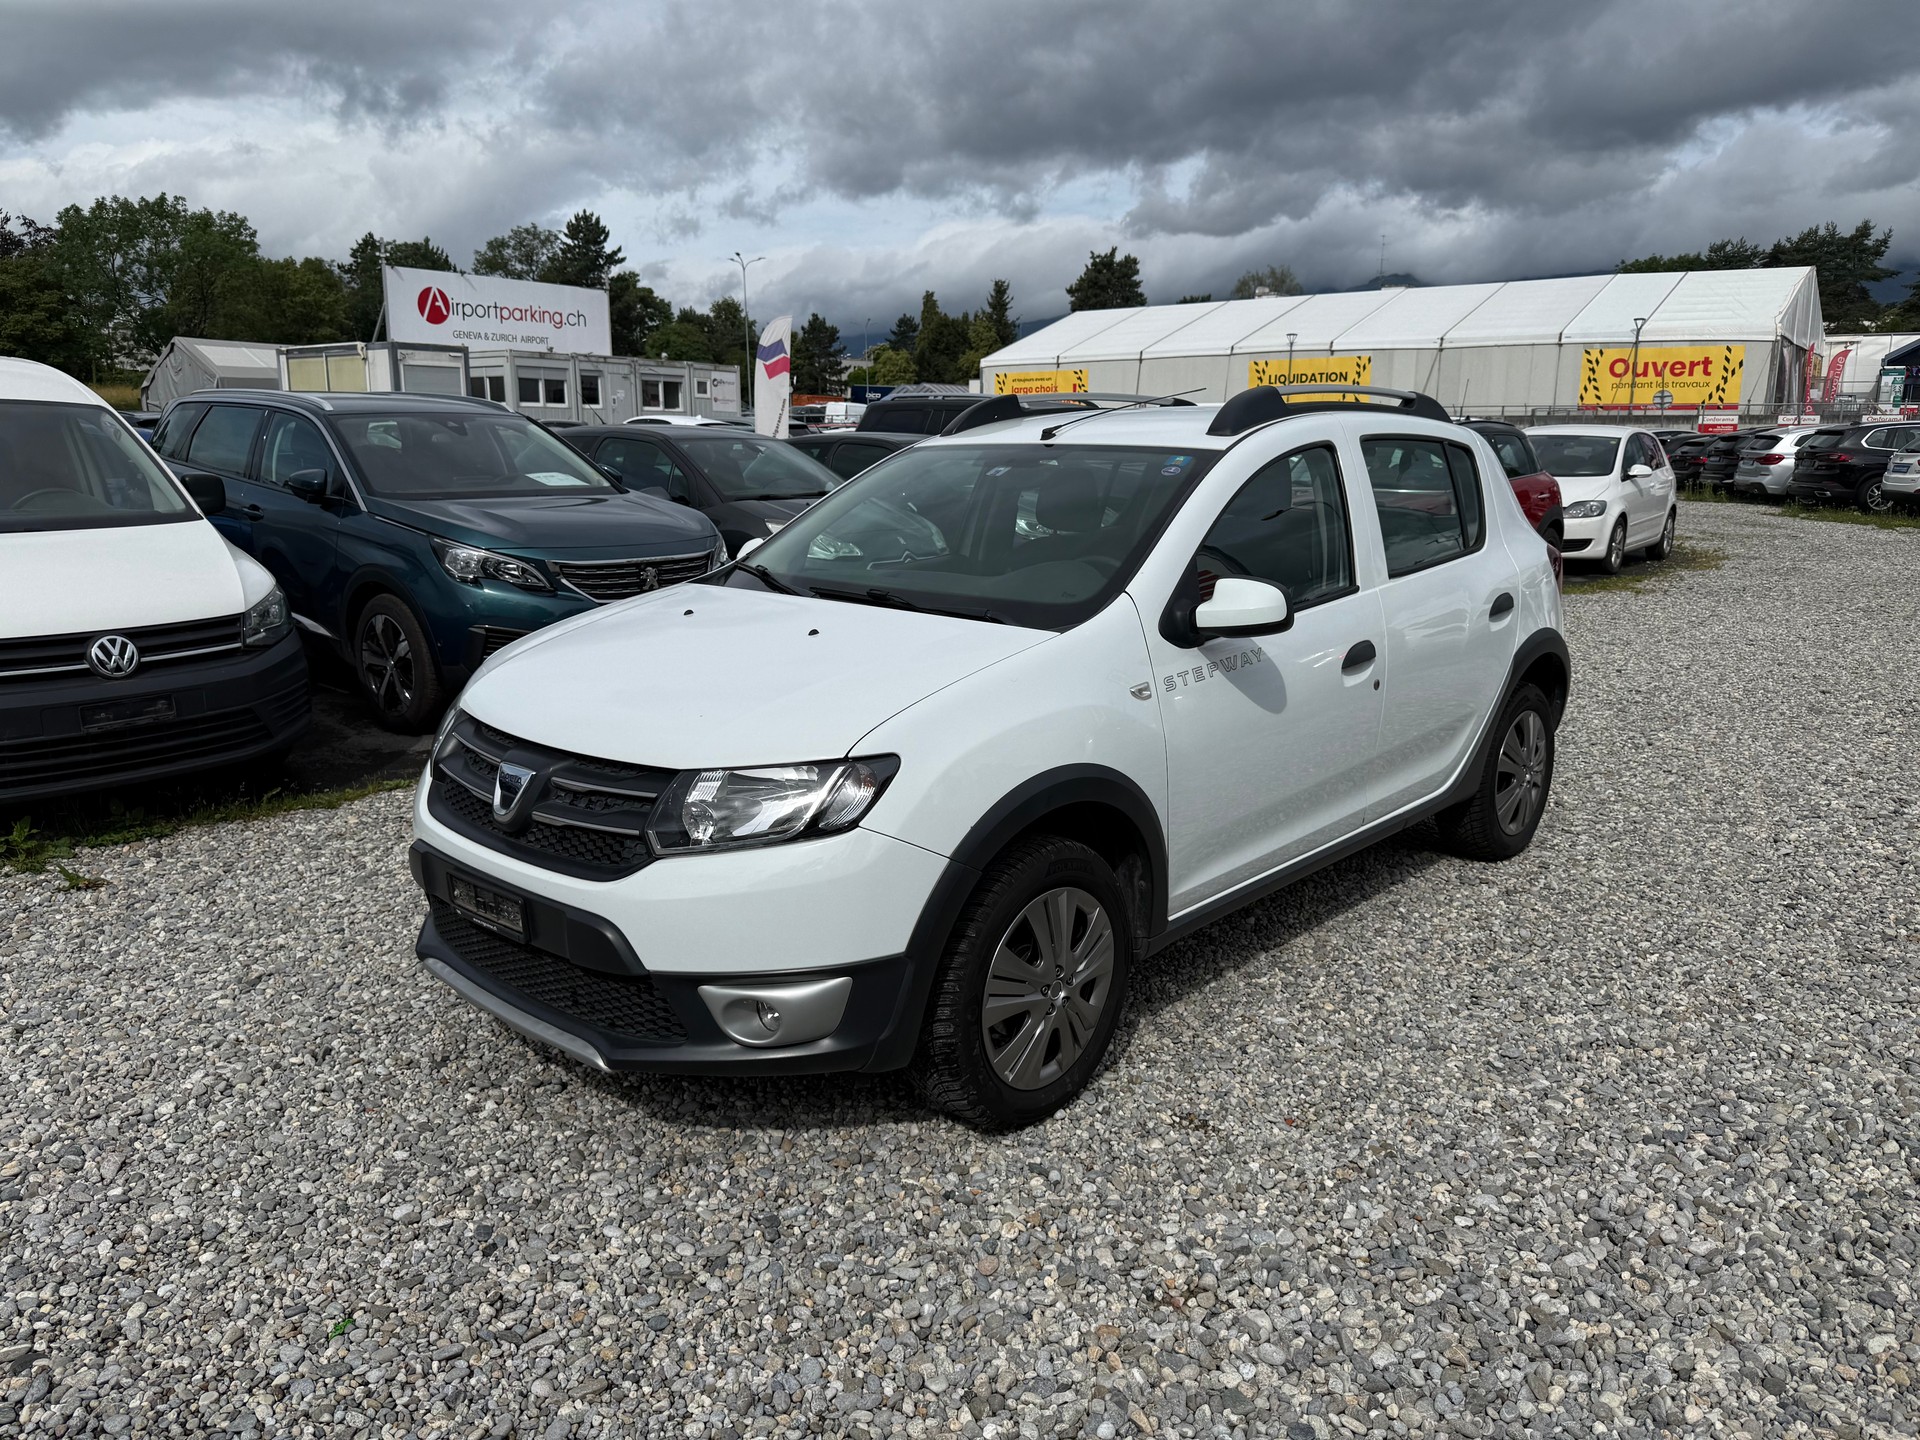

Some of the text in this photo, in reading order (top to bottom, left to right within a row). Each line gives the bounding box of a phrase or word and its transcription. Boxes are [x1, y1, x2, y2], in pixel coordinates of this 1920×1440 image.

[418, 286, 587, 329] Airportparking.ch
[452, 329, 549, 345] GENEVA & ZURICH AIRPORT
[1609, 356, 1713, 378] Ouvert
[1268, 371, 1348, 386] LIQUIDATION
[1611, 380, 1711, 391] pendant les travaux
[1011, 383, 1058, 395] large choix
[1163, 647, 1265, 692] STEPWAY
[499, 771, 524, 786] DACIA
